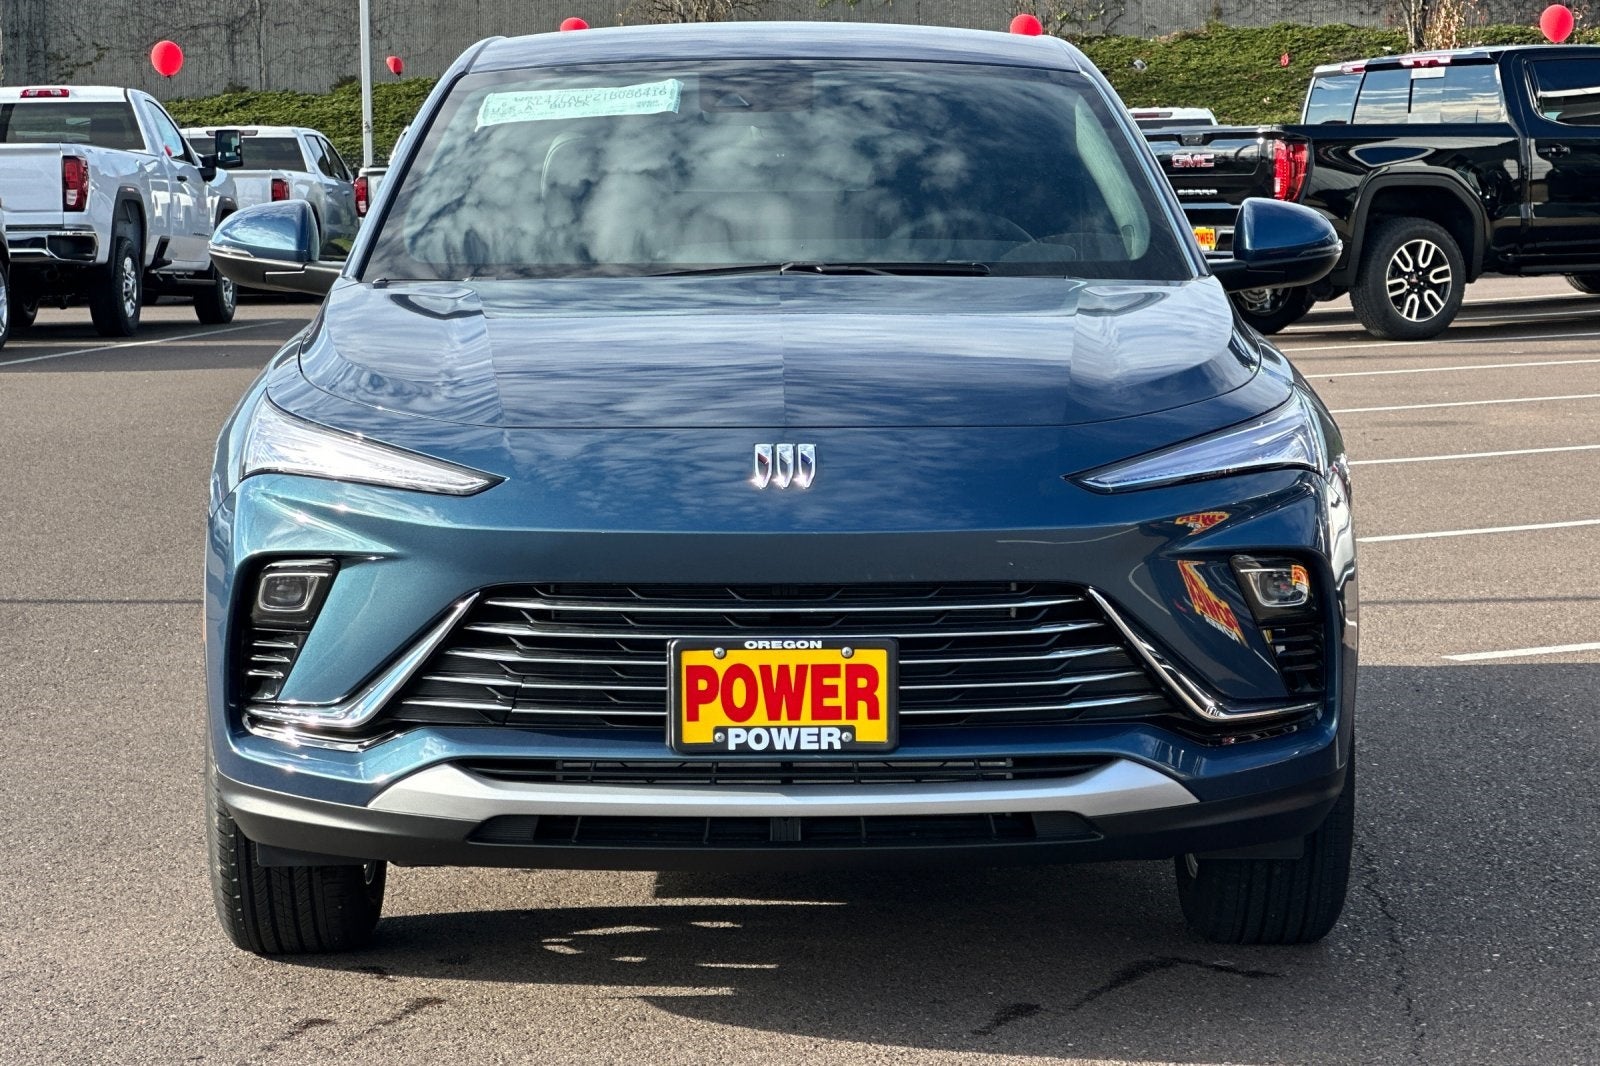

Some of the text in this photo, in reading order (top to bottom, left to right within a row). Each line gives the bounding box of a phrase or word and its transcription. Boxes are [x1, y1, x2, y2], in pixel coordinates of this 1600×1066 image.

[1172, 153, 1214, 167] GMC
[1195, 233, 1214, 244] OWER
[744, 640, 822, 649] OREGON
[686, 663, 880, 722] POWER
[728, 727, 841, 751] POWER
